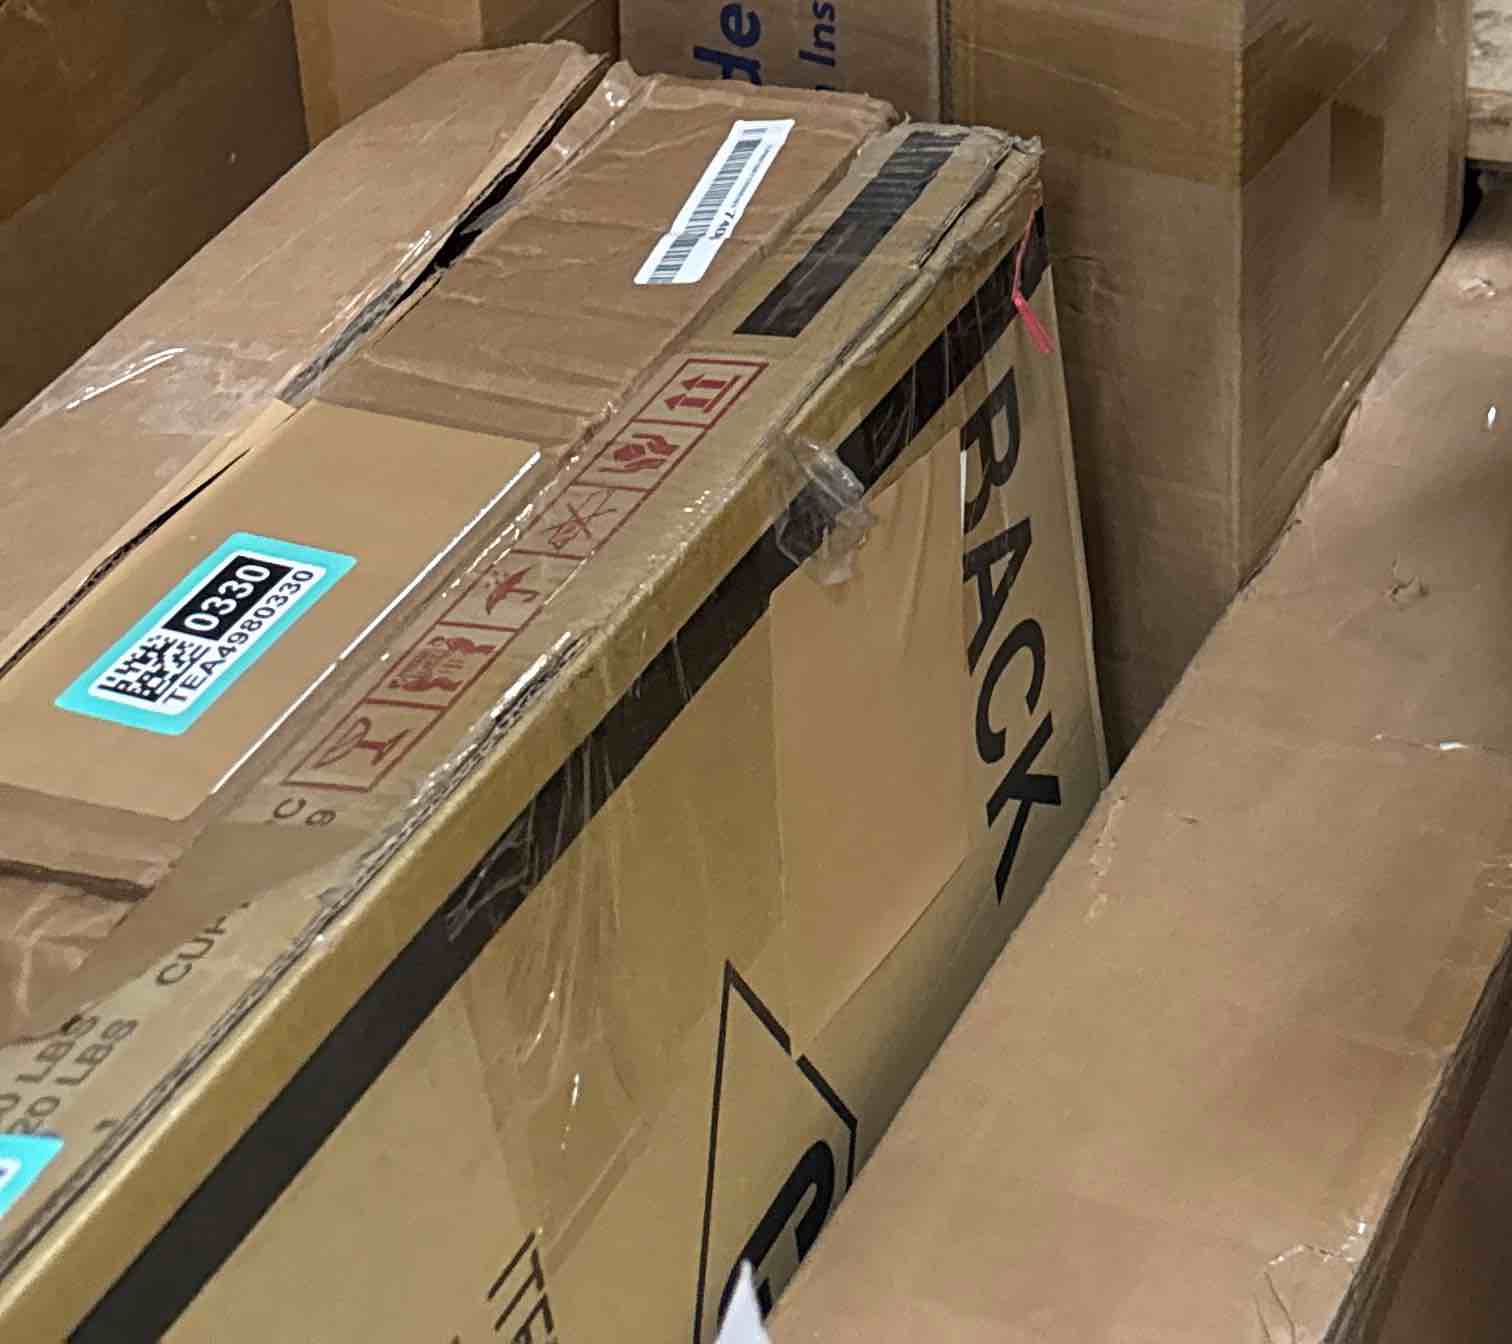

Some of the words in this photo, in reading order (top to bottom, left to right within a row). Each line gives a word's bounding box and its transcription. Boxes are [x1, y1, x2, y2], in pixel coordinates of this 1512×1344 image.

[161, 569, 315, 705] TEA4980330
[183, 563, 272, 633] 0330
[959, 365, 1062, 905] RACK
